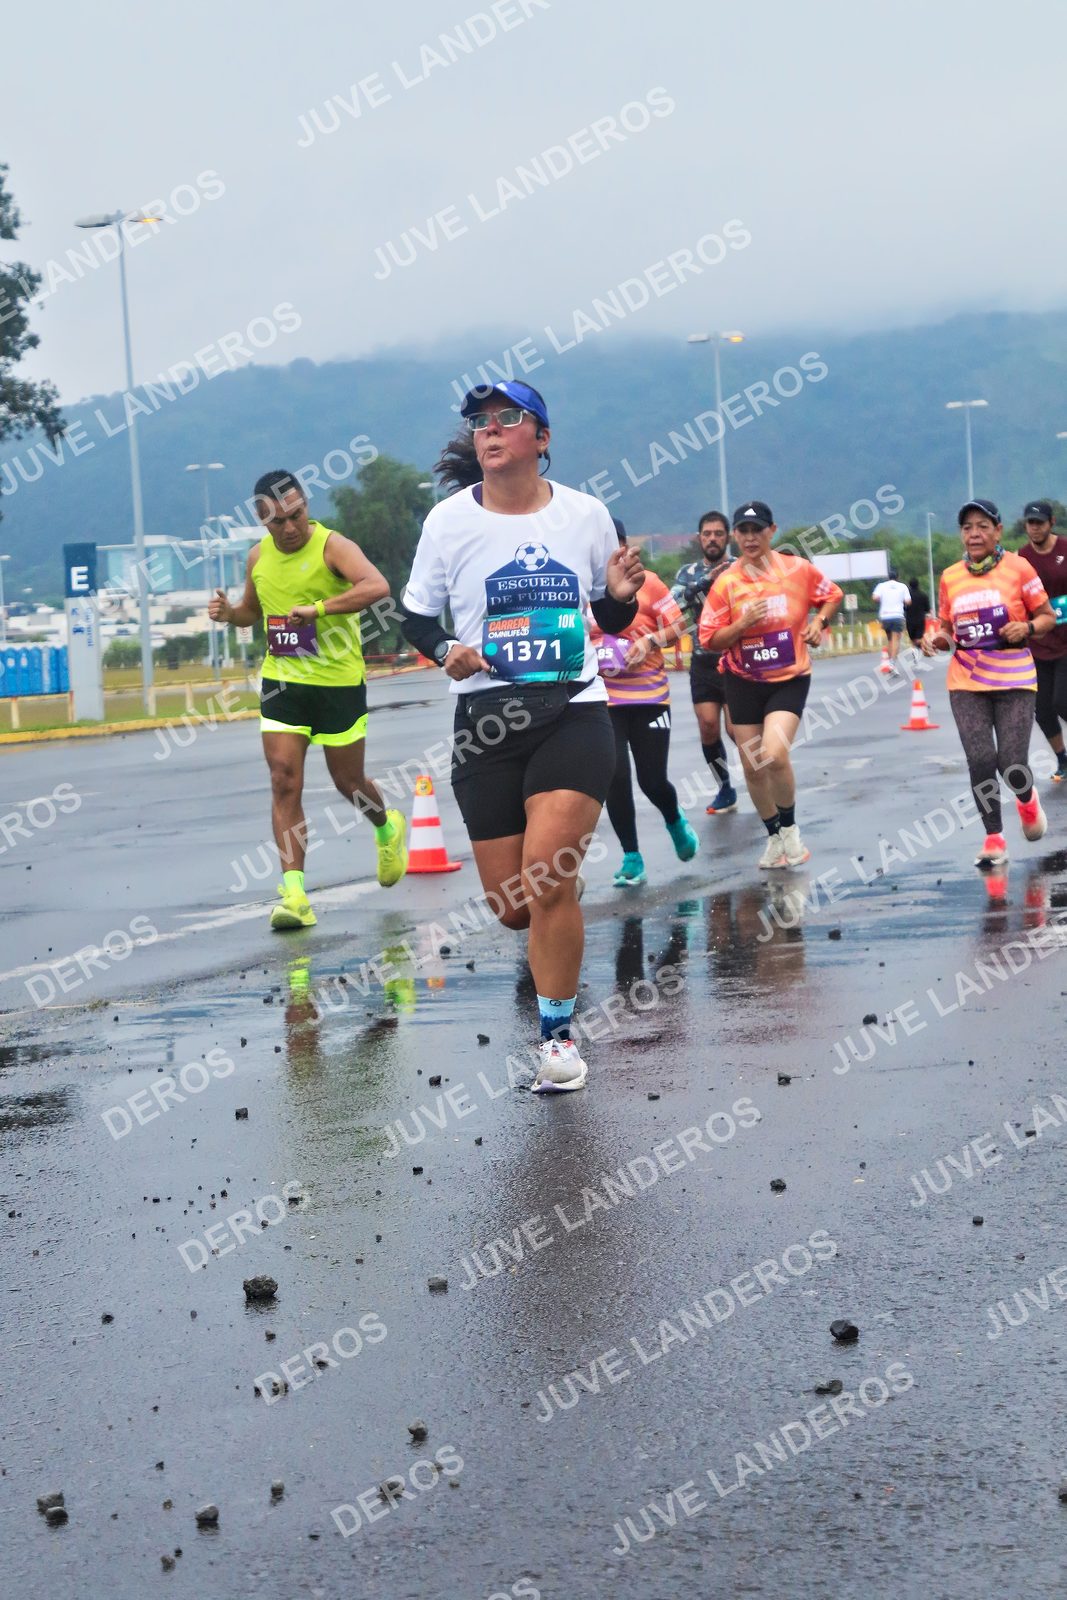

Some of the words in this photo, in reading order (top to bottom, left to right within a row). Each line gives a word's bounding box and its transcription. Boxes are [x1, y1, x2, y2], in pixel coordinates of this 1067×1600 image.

[71, 566, 89, 591] E
[498, 577, 570, 591] ESCUELA
[490, 594, 512, 606] DE
[517, 589, 578, 602] FÚTBOL
[488, 617, 530, 631] CARRERA
[558, 614, 576, 628] 10K
[967, 622, 994, 638] 322
[275, 632, 299, 645] 178
[502, 639, 561, 662] 1371
[753, 647, 779, 661] 486
